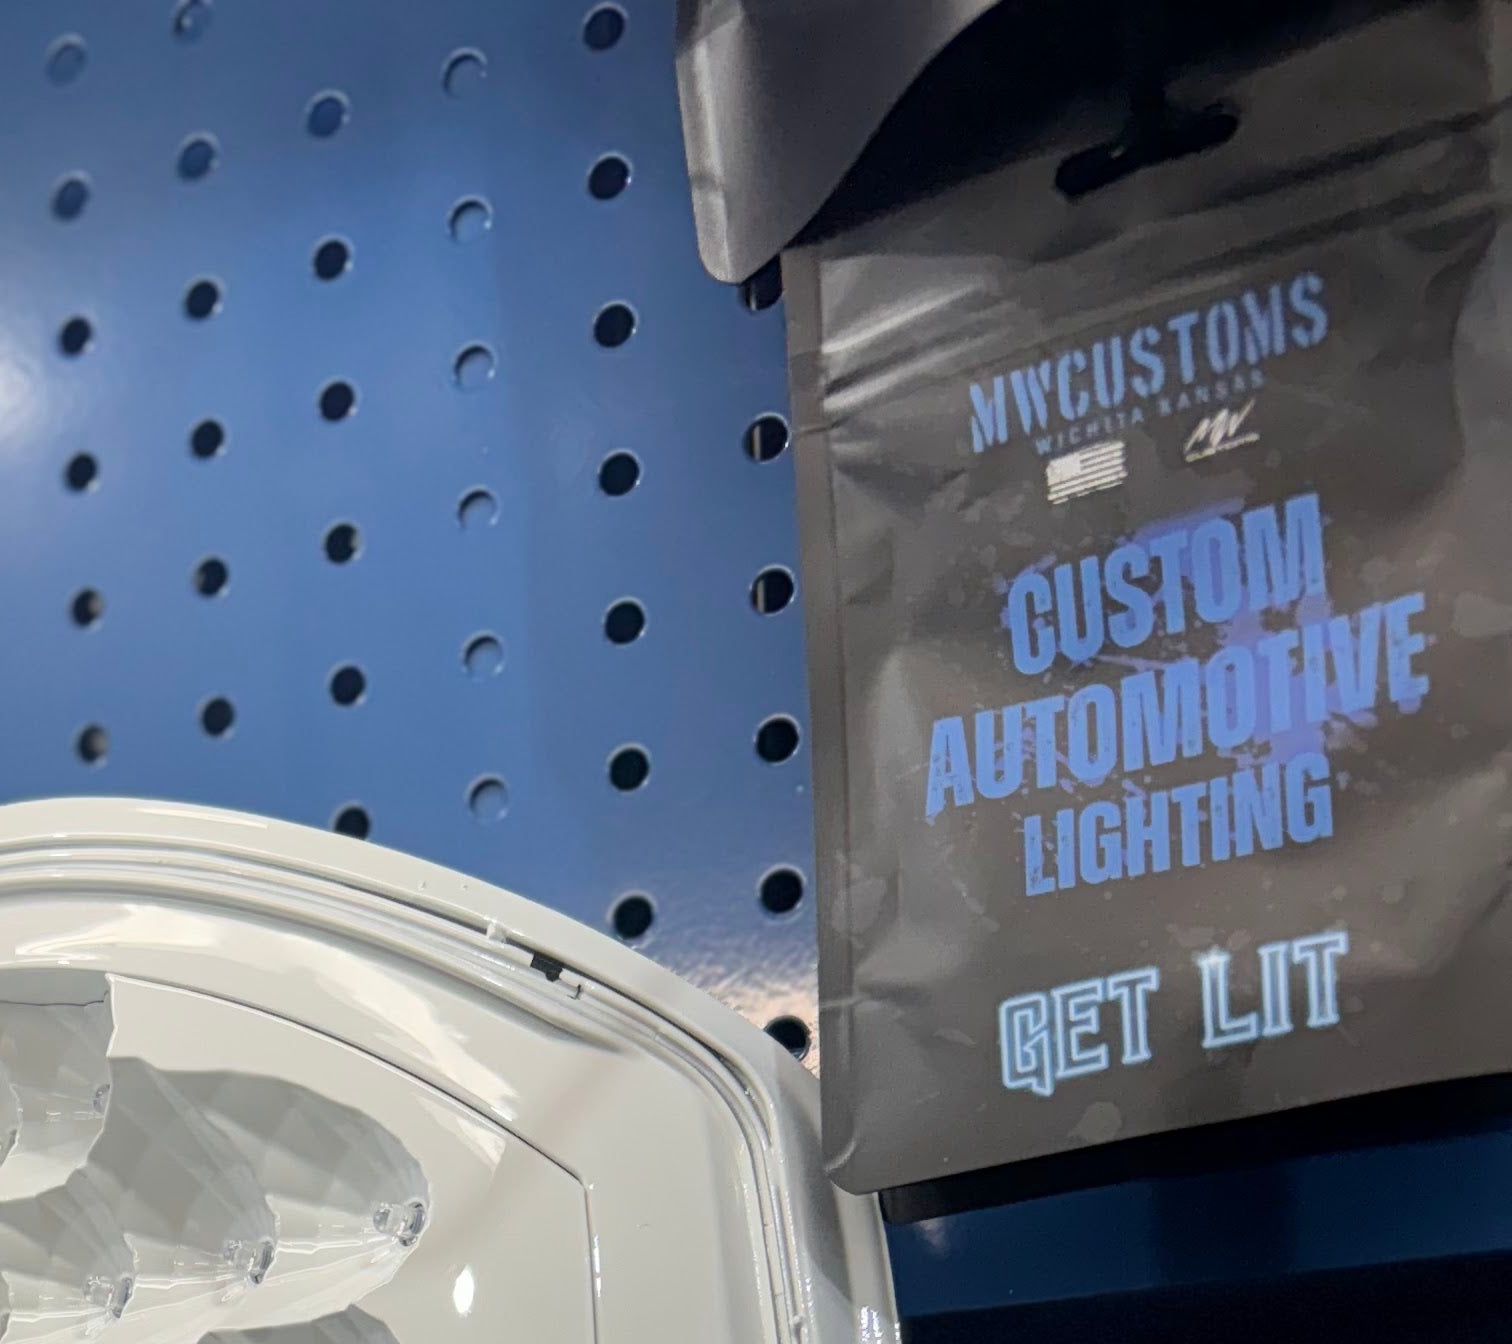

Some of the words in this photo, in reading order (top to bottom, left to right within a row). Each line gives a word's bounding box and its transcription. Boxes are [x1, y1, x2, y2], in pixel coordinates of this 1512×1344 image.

[969, 271, 1328, 453] MWCUSTOMS
[1035, 406, 1144, 456] WICHITA
[1159, 368, 1265, 418] KANSAS
[1008, 493, 1326, 675] CUSTOM
[925, 592, 1430, 824] AUTOMOTIVE
[1024, 751, 1334, 897] LIGHTING
[999, 966, 1160, 1097] GET
[1196, 930, 1349, 1049] LIT
